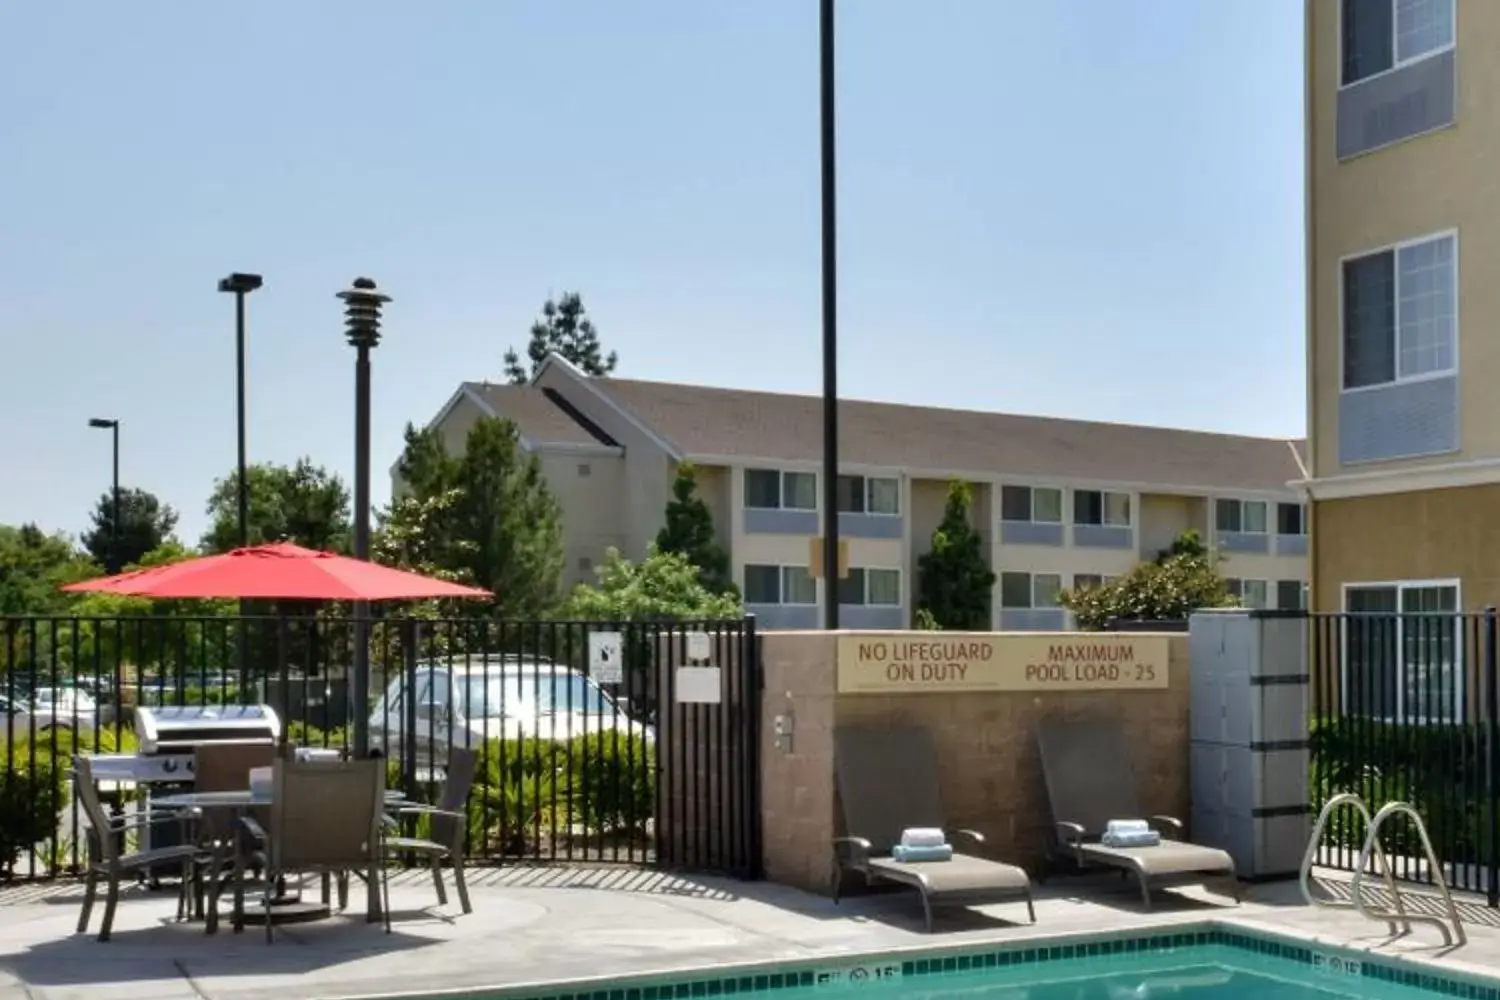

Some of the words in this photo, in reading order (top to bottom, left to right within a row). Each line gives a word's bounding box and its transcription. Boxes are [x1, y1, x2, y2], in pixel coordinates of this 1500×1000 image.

[859, 643, 887, 661] NO
[893, 644, 993, 661] LIFEGUARD
[1049, 645, 1134, 661] MAXIMUM
[886, 664, 916, 681] ON
[922, 664, 968, 681] DUTY
[1025, 666, 1070, 682] POOL
[1075, 665, 1119, 682] LOAD
[1135, 665, 1156, 681] 25
